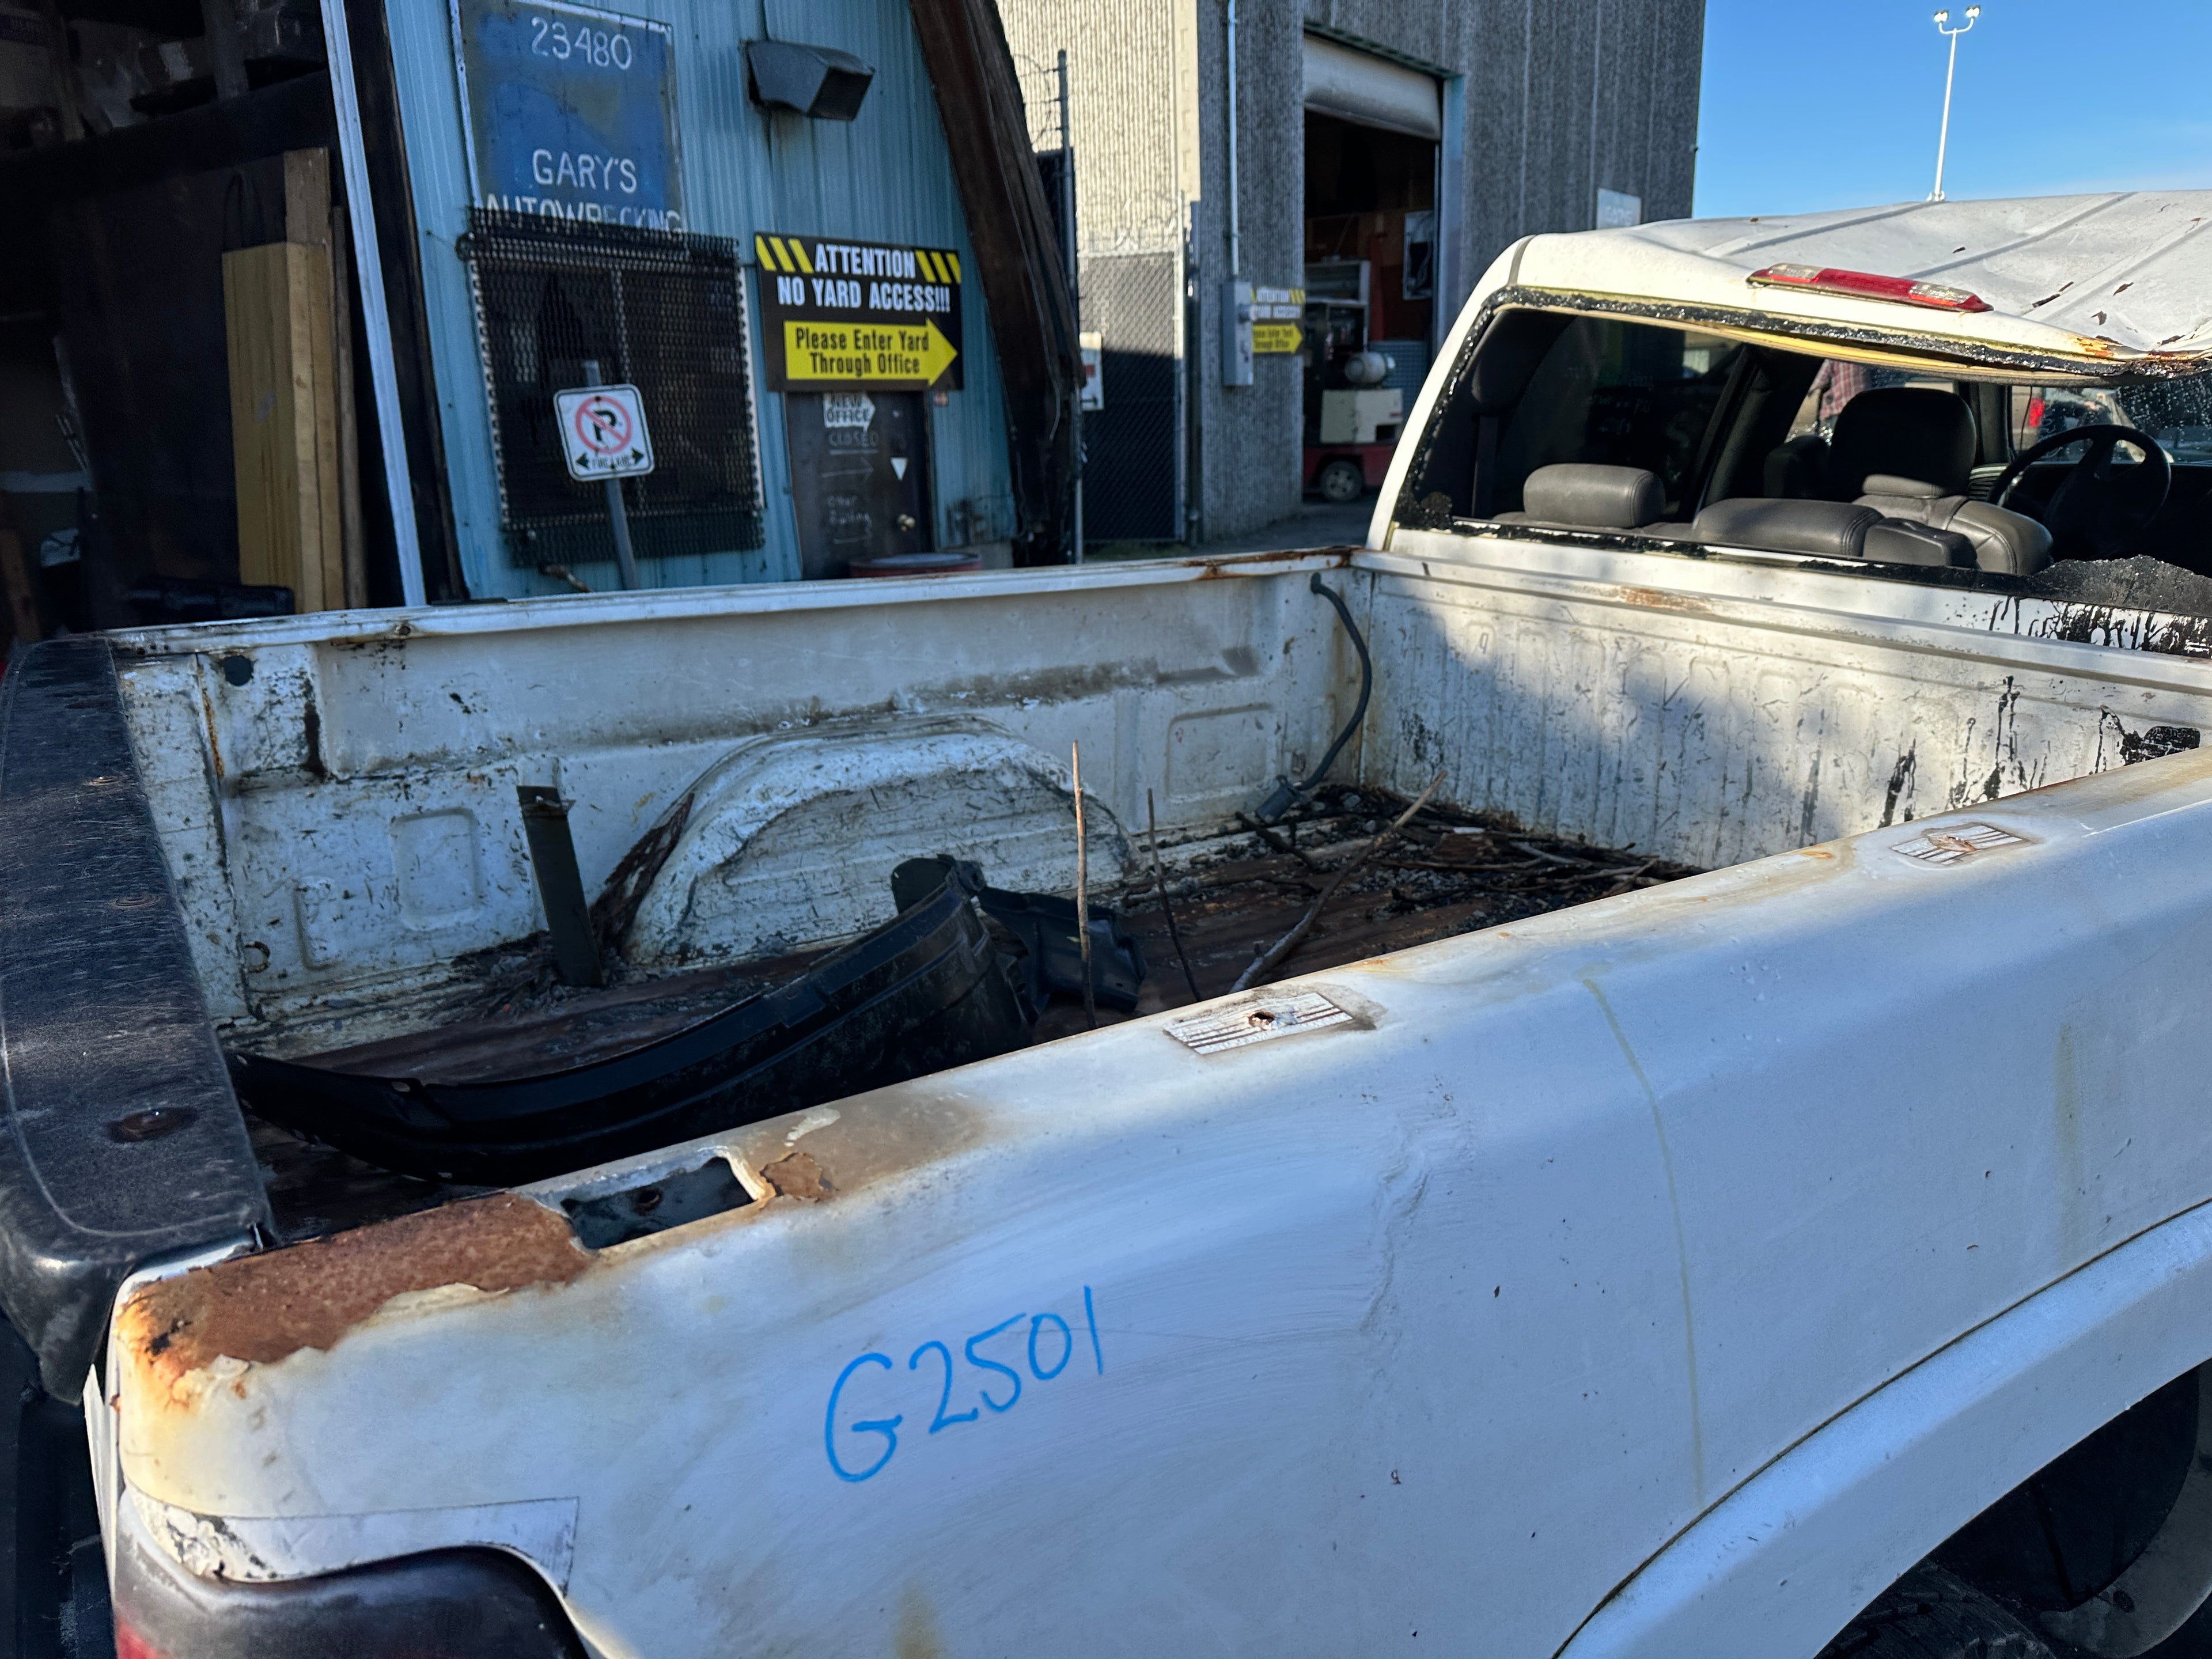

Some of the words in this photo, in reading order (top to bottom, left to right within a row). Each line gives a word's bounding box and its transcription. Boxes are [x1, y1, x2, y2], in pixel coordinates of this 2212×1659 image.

[531, 16, 632, 70] 23480
[532, 148, 637, 193] GARY'S
[815, 243, 916, 279] ATTENTION
[777, 275, 805, 306] NO
[811, 278, 862, 308] YARD
[869, 281, 950, 313] ACCESS!!!
[795, 327, 847, 350] Please
[853, 329, 893, 351] Enter
[899, 330, 929, 351] Yard
[810, 353, 872, 378] Through
[878, 353, 920, 374] Office
[825, 1285, 1103, 1483] G2501
